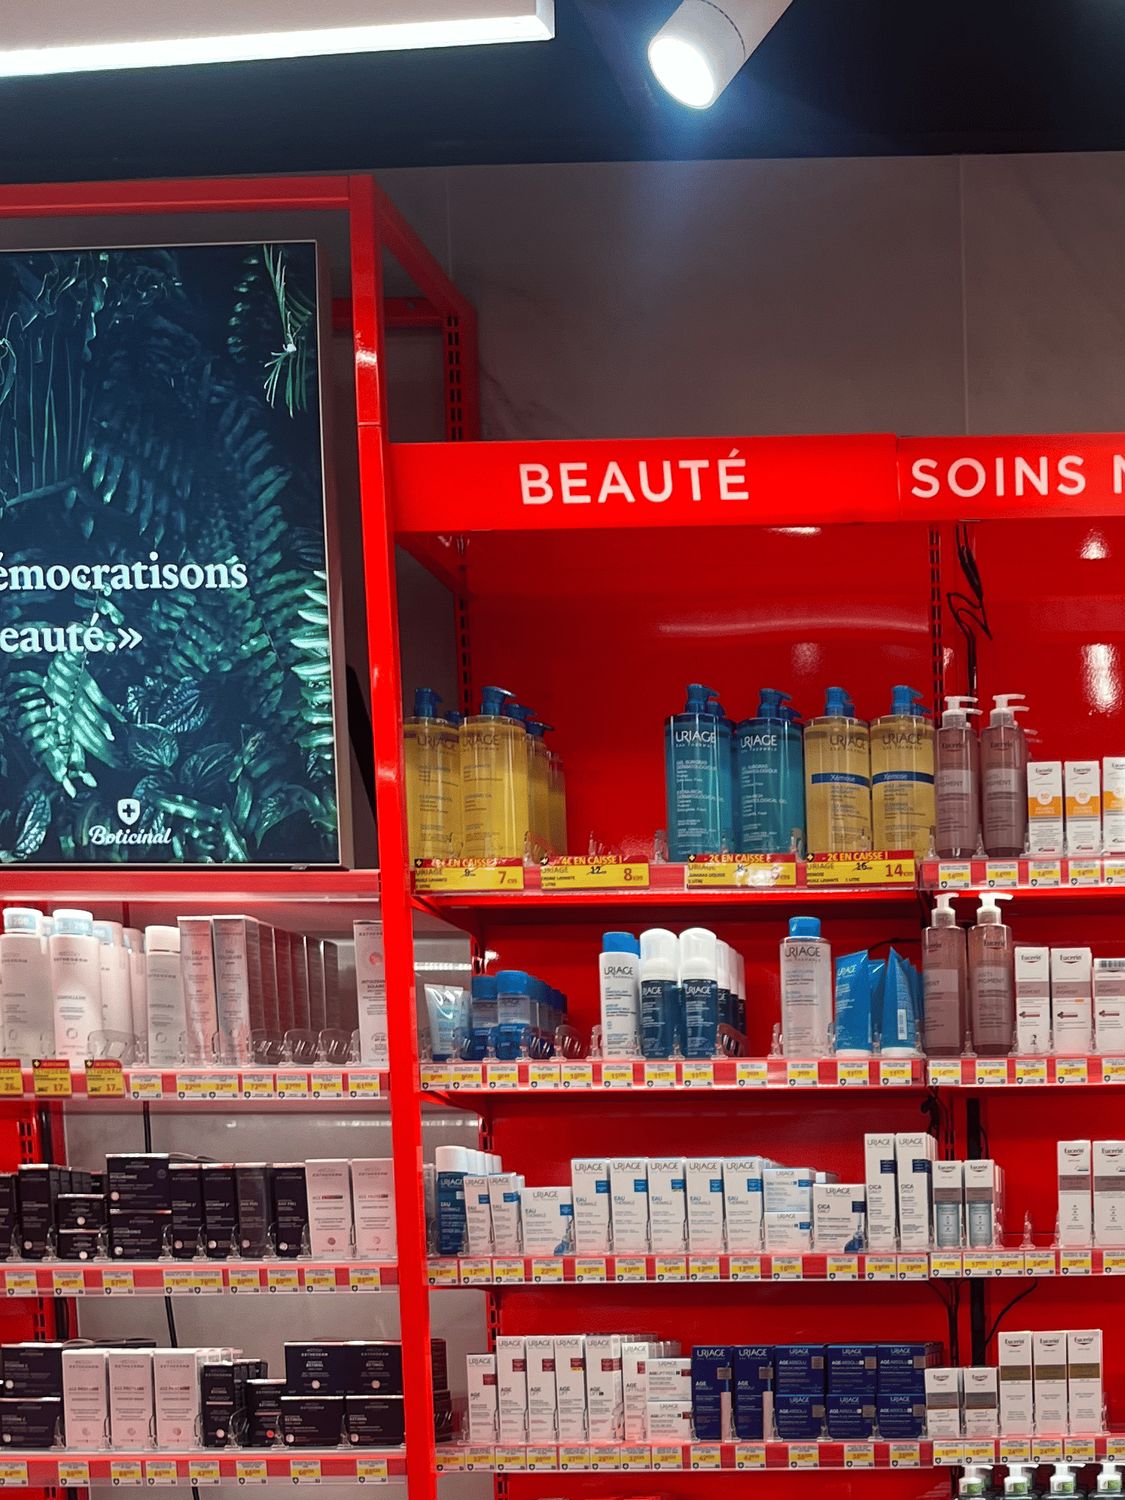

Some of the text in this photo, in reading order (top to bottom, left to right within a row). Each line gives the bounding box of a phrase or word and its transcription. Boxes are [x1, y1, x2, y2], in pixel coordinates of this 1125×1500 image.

[518, 448, 749, 505] BEAUTÉ
[911, 455, 1087, 499] SOINS
[675, 730, 717, 744] URIAGE
[740, 735, 777, 749] URIAGE
[882, 733, 922, 748] URIAGE
[88, 825, 172, 846] Boticinal
[735, 853, 766, 863] CAISSE
[839, 853, 852, 862] EN
[853, 852, 882, 862] CAISSE
[785, 946, 821, 958] URIAGE
[603, 966, 634, 977] URIAGE
[867, 1138, 890, 1146] URIAGE
[899, 1137, 923, 1146] URIAGE
[575, 1163, 602, 1173] URIAGE
[613, 1162, 641, 1172] URIAGE
[650, 1162, 678, 1172] URIAGE
[689, 1161, 718, 1171] URIAGE
[726, 1161, 755, 1171] URIAGE
[532, 1191, 558, 1199] URIAGE
[826, 1187, 851, 1195] URIAGE
[498, 1339, 521, 1349] URIAGE
[527, 1339, 551, 1349] URIAGE
[555, 1339, 579, 1348] URIAGE
[586, 1339, 610, 1349] URIAGE
[697, 1349, 725, 1359] URIAGE
[468, 1358, 491, 1366] URIAGE
